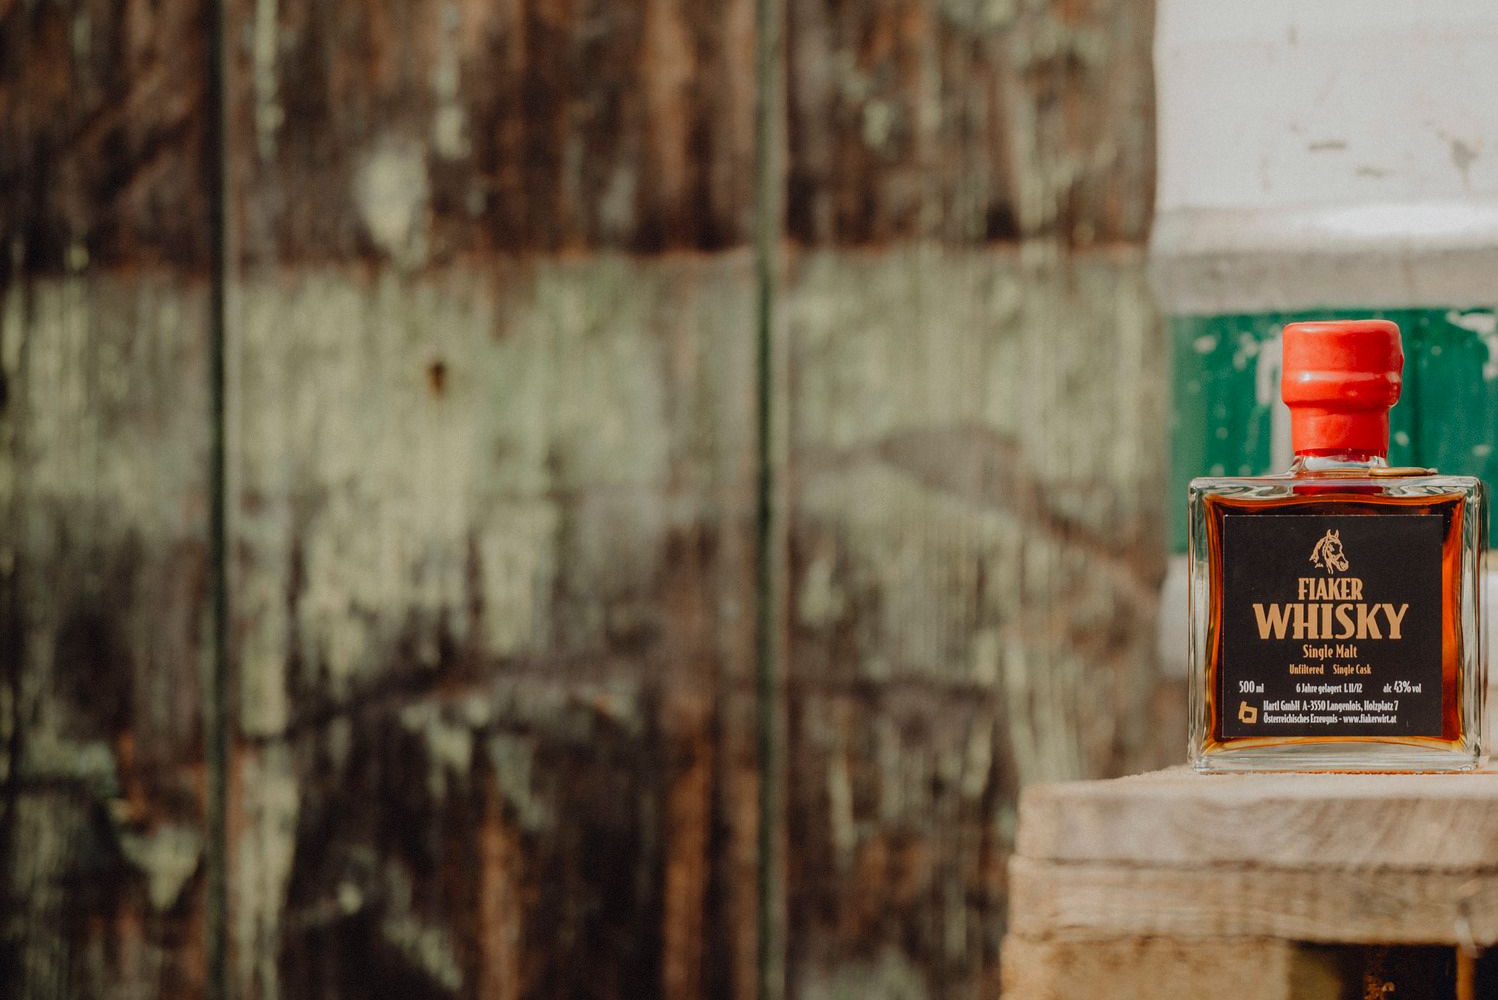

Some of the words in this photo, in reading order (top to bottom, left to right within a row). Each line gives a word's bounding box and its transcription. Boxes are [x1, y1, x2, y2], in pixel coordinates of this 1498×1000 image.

[1298, 577, 1364, 600] FIAKER
[1252, 603, 1409, 640] WHISKY
[1303, 644, 1334, 661] Single
[1336, 644, 1358, 659] Malt
[1289, 663, 1325, 675] Unfiltered
[1333, 663, 1355, 677] Single
[1356, 663, 1372, 675] Cask
[1239, 680, 1255, 693] 500
[1256, 683, 1265, 693] ml
[1296, 683, 1301, 693] 6
[1301, 683, 1317, 693] Jahre
[1318, 683, 1342, 695] gelagert
[1393, 680, 1412, 693] 43%
[1412, 683, 1422, 693] vol
[1263, 700, 1280, 711] Hartl
[1280, 700, 1300, 711] GmbH
[1302, 700, 1326, 711] A-3550
[1326, 700, 1363, 713] Langenlois,
[1364, 700, 1394, 713] Holzplatz
[1394, 700, 1399, 711] 7
[1263, 712, 1309, 724] Österreichisches
[1310, 713, 1338, 725] Erzeugnis
[1343, 713, 1397, 724] www.fiakerwirt.at
